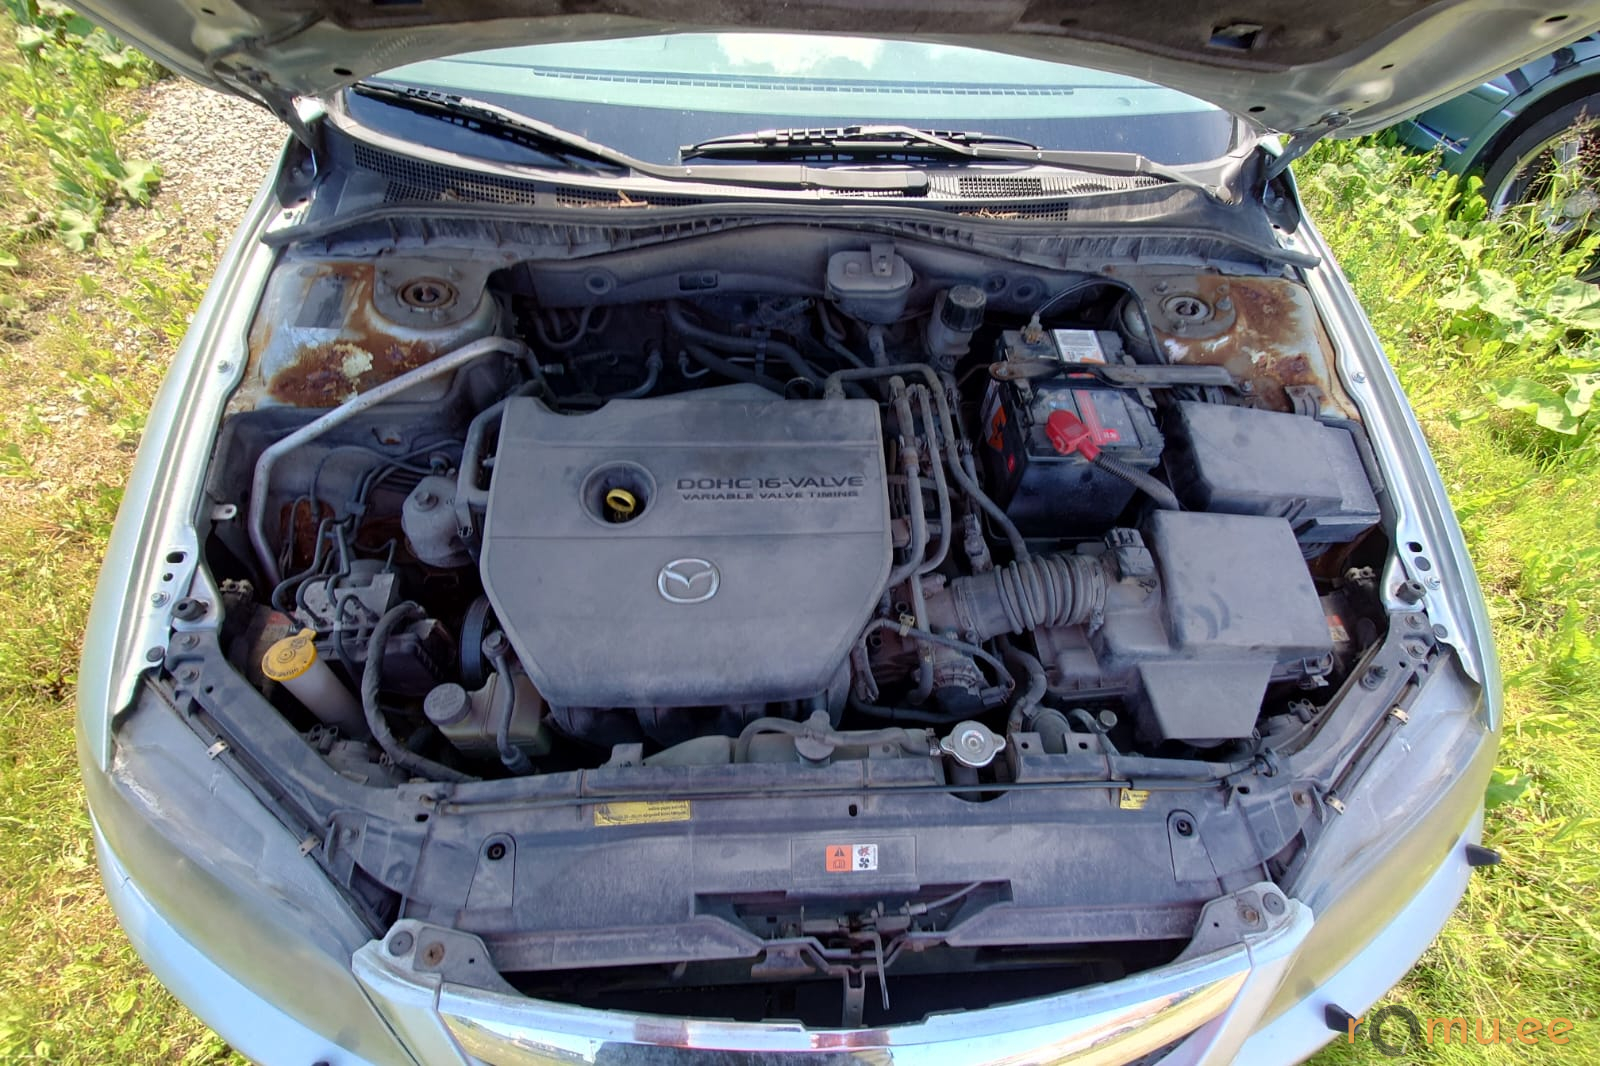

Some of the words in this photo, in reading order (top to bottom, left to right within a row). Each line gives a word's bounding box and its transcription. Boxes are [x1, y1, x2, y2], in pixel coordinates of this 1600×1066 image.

[676, 477, 751, 490] DOHC
[758, 475, 864, 489] 16-VALVE
[682, 492, 754, 501] VARIABLE
[759, 491, 803, 499] VALVE
[810, 490, 859, 498] TIMING
